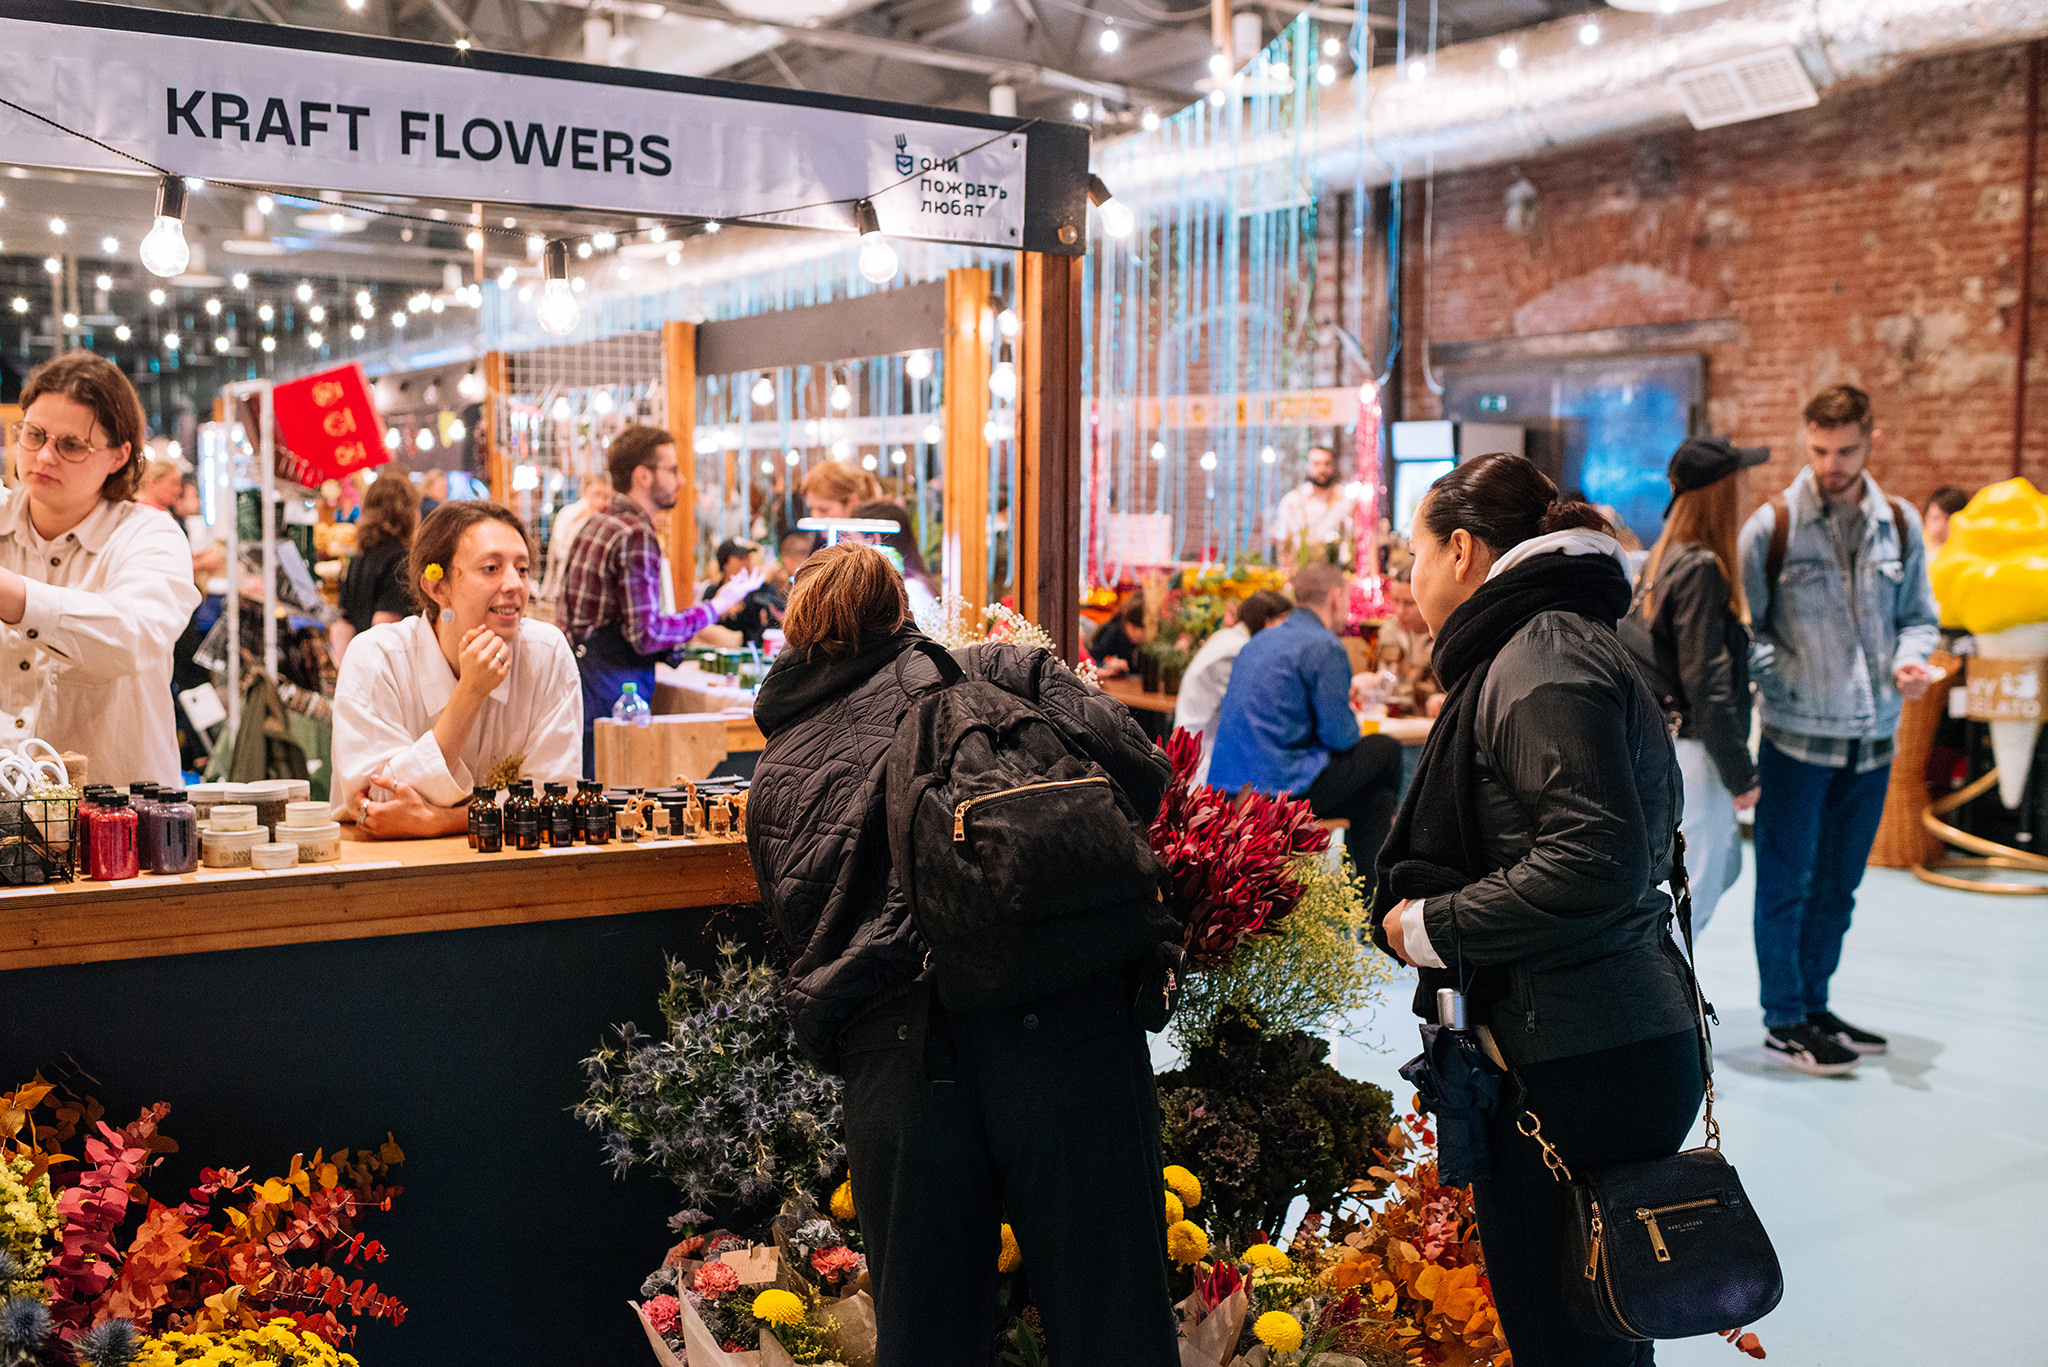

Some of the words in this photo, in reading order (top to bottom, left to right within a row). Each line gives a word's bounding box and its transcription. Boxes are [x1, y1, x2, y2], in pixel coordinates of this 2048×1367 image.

[166, 87, 370, 151] KRAFT
[400, 110, 672, 177] FLOWERS
[920, 157, 959, 174] они
[920, 178, 1008, 200] пожрать
[920, 199, 985, 218] любят
